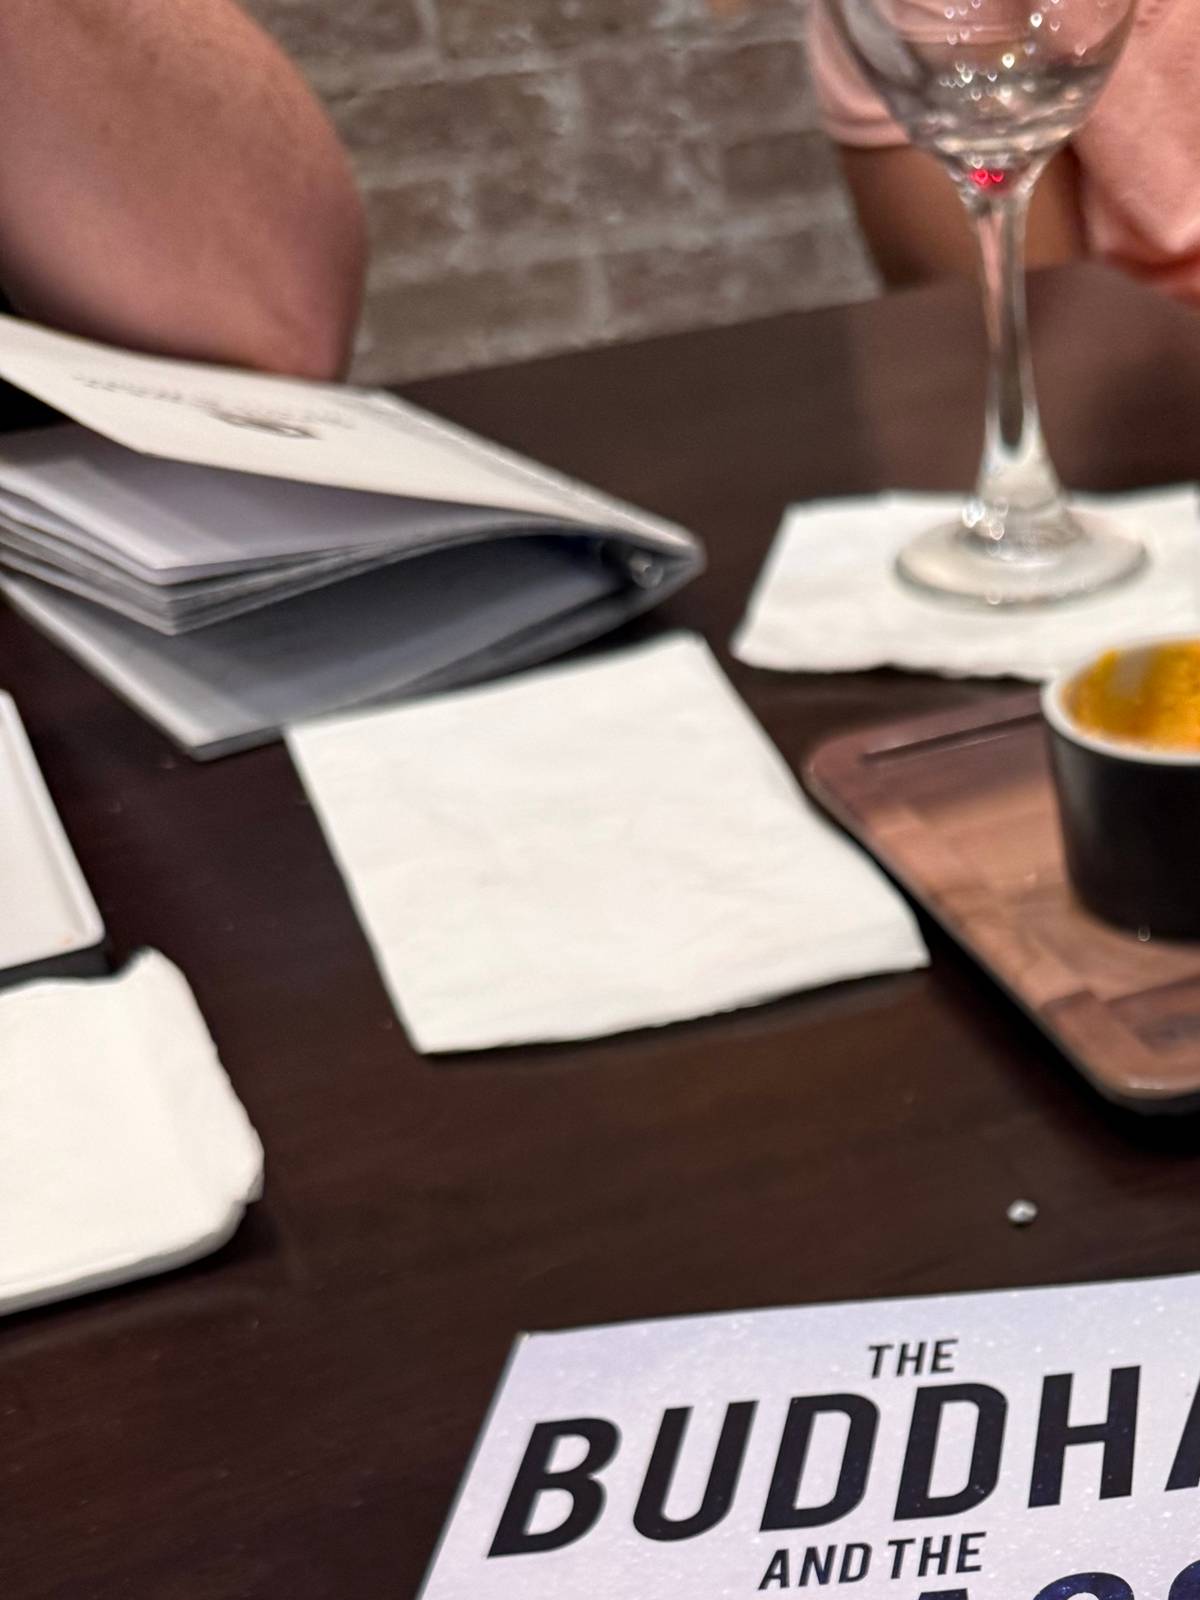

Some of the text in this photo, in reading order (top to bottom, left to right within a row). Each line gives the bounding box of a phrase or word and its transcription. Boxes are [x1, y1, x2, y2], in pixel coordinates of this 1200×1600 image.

[867, 1339, 958, 1380] THE
[758, 1532, 987, 1591] AND THE
